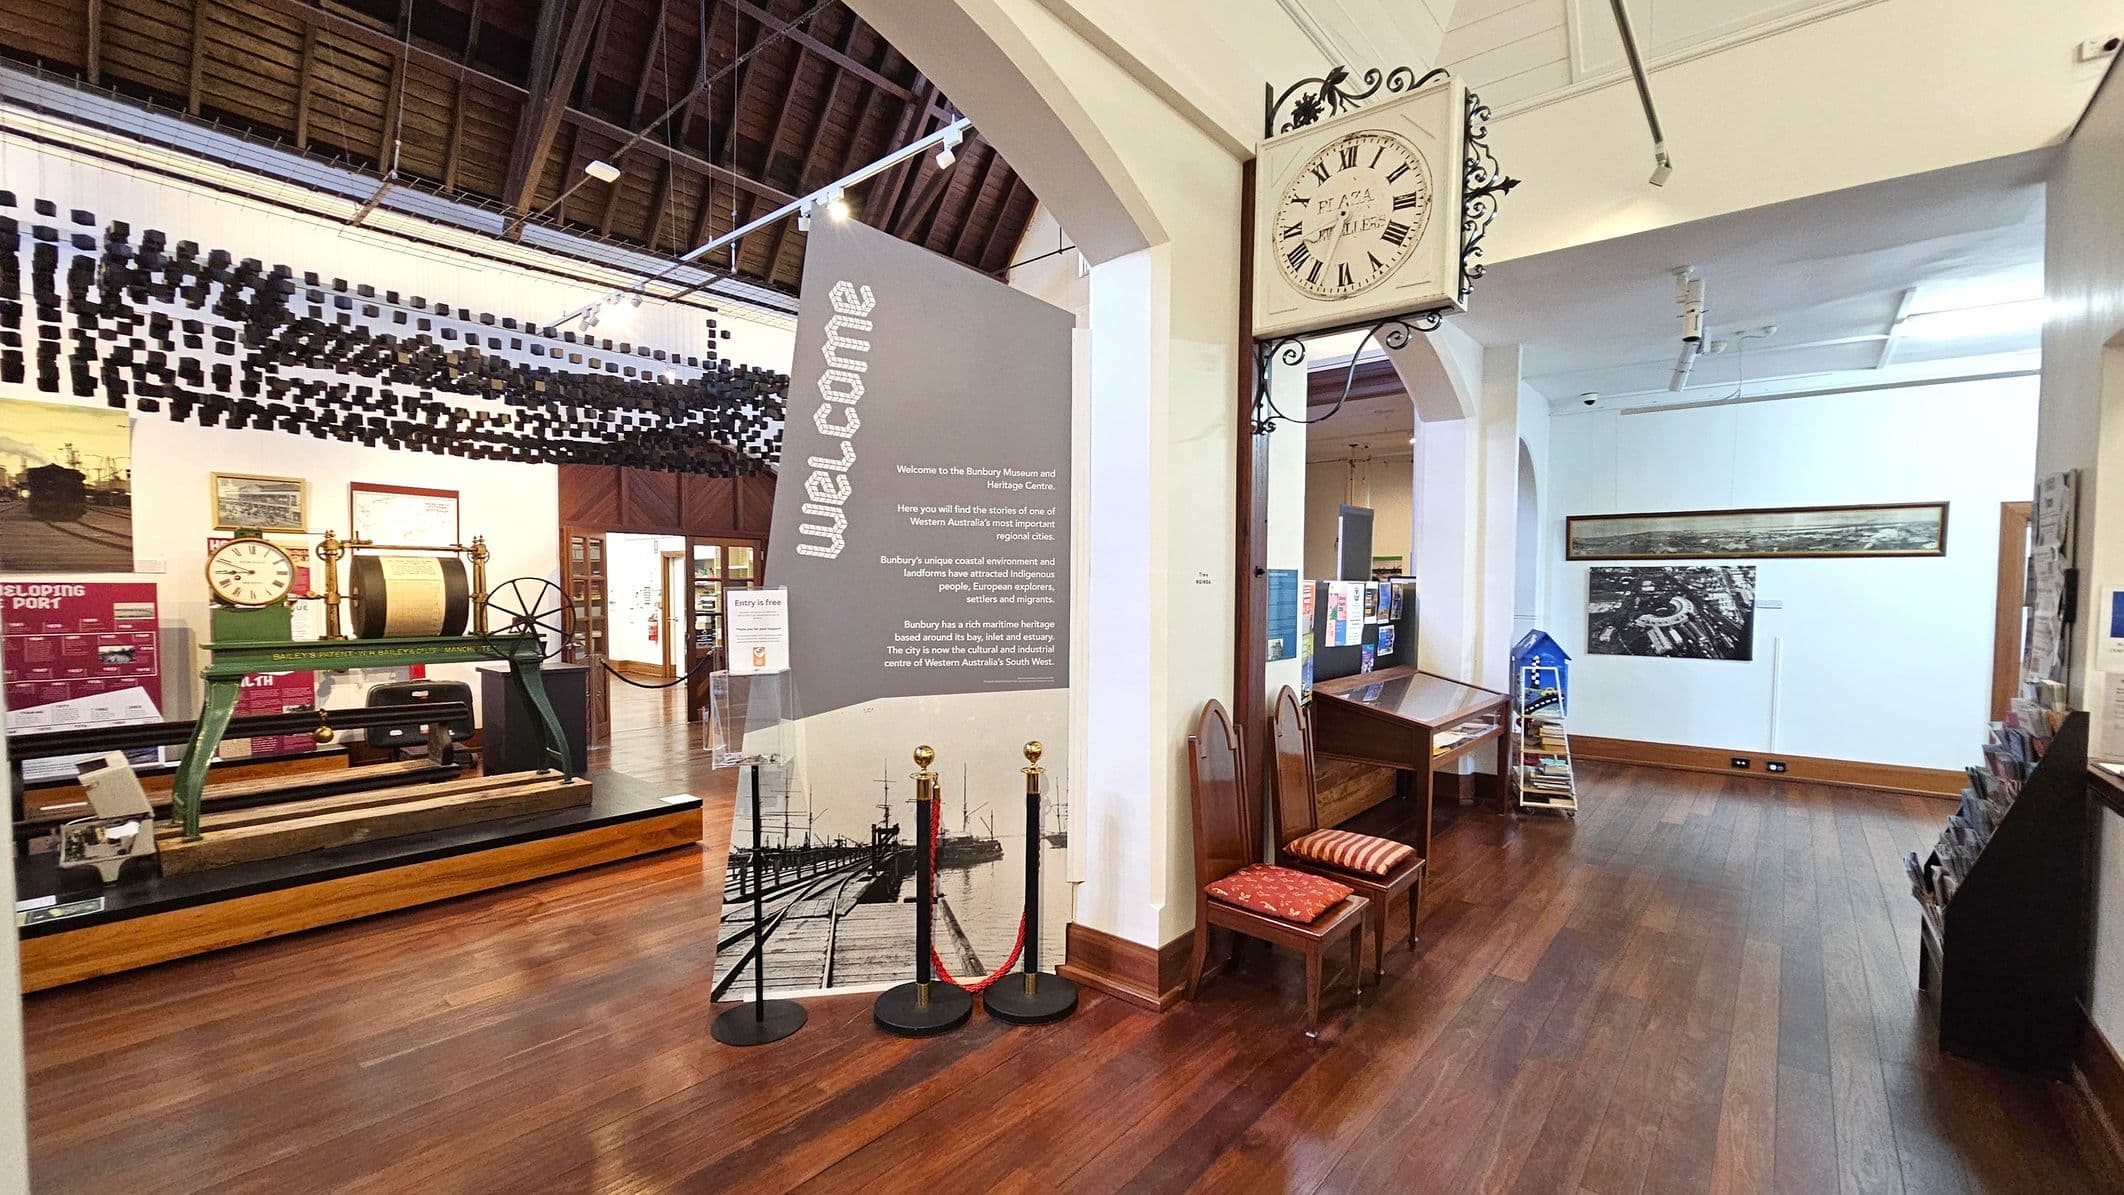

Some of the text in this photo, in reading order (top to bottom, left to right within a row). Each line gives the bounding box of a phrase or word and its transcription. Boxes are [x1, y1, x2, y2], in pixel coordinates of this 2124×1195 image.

[1337, 144, 1359, 173] XII
[1368, 146, 1385, 169] I
[1310, 161, 1332, 187] XI
[1386, 161, 1411, 185] II
[1291, 193, 1311, 208] X
[1318, 188, 1376, 215] PLAZA
[1392, 191, 1417, 212] III
[1283, 221, 1303, 240] IX
[1381, 219, 1410, 247] IIII
[1367, 251, 1385, 272] V
[1338, 262, 1354, 287] VI
[896, 465, 1056, 478] Welcome to the Bunbury Museum and
[987, 480, 1055, 491] Heritage Centre.
[897, 504, 918, 513] Here
[920, 506, 937, 515] you
[938, 505, 953, 513] will
[954, 505, 971, 513] find
[972, 505, 987, 514] the
[989, 506, 1017, 515] stories
[1018, 506, 1028, 515] of
[1046, 507, 1056, 515] of
[910, 517, 946, 526] Western
[947, 518, 990, 527] Australia's
[1015, 519, 1055, 530] important
[996, 532, 1055, 542] regional cities.
[880, 555, 1055, 567] Bunbury's unique coastal environment and
[904, 568, 1055, 580] landforms have attracted Indigenous
[939, 582, 1055, 593] people, European explorers,
[13, 597, 62, 609] PORT
[735, 599, 756, 608] Entry
[966, 594, 1055, 605] settlers and migrants.
[904, 620, 940, 631] Bunbury
[941, 620, 956, 628] has
[965, 620, 981, 628] rich
[982, 620, 1019, 628] maritime
[1021, 620, 1055, 630] heritage
[894, 632, 1055, 643] based around its bay, inlet and estuary.
[886, 646, 903, 654] The
[905, 646, 921, 656] city
[922, 646, 930, 654] is
[951, 645, 966, 654] the
[967, 645, 998, 654] cultural
[1000, 645, 1016, 653] and
[1018, 644, 1055, 653] industrial
[913, 658, 923, 667] of
[924, 658, 960, 667] Western
[961, 658, 1004, 666] Australia's
[1005, 657, 1030, 666] South
[1031, 657, 1055, 666] West.
